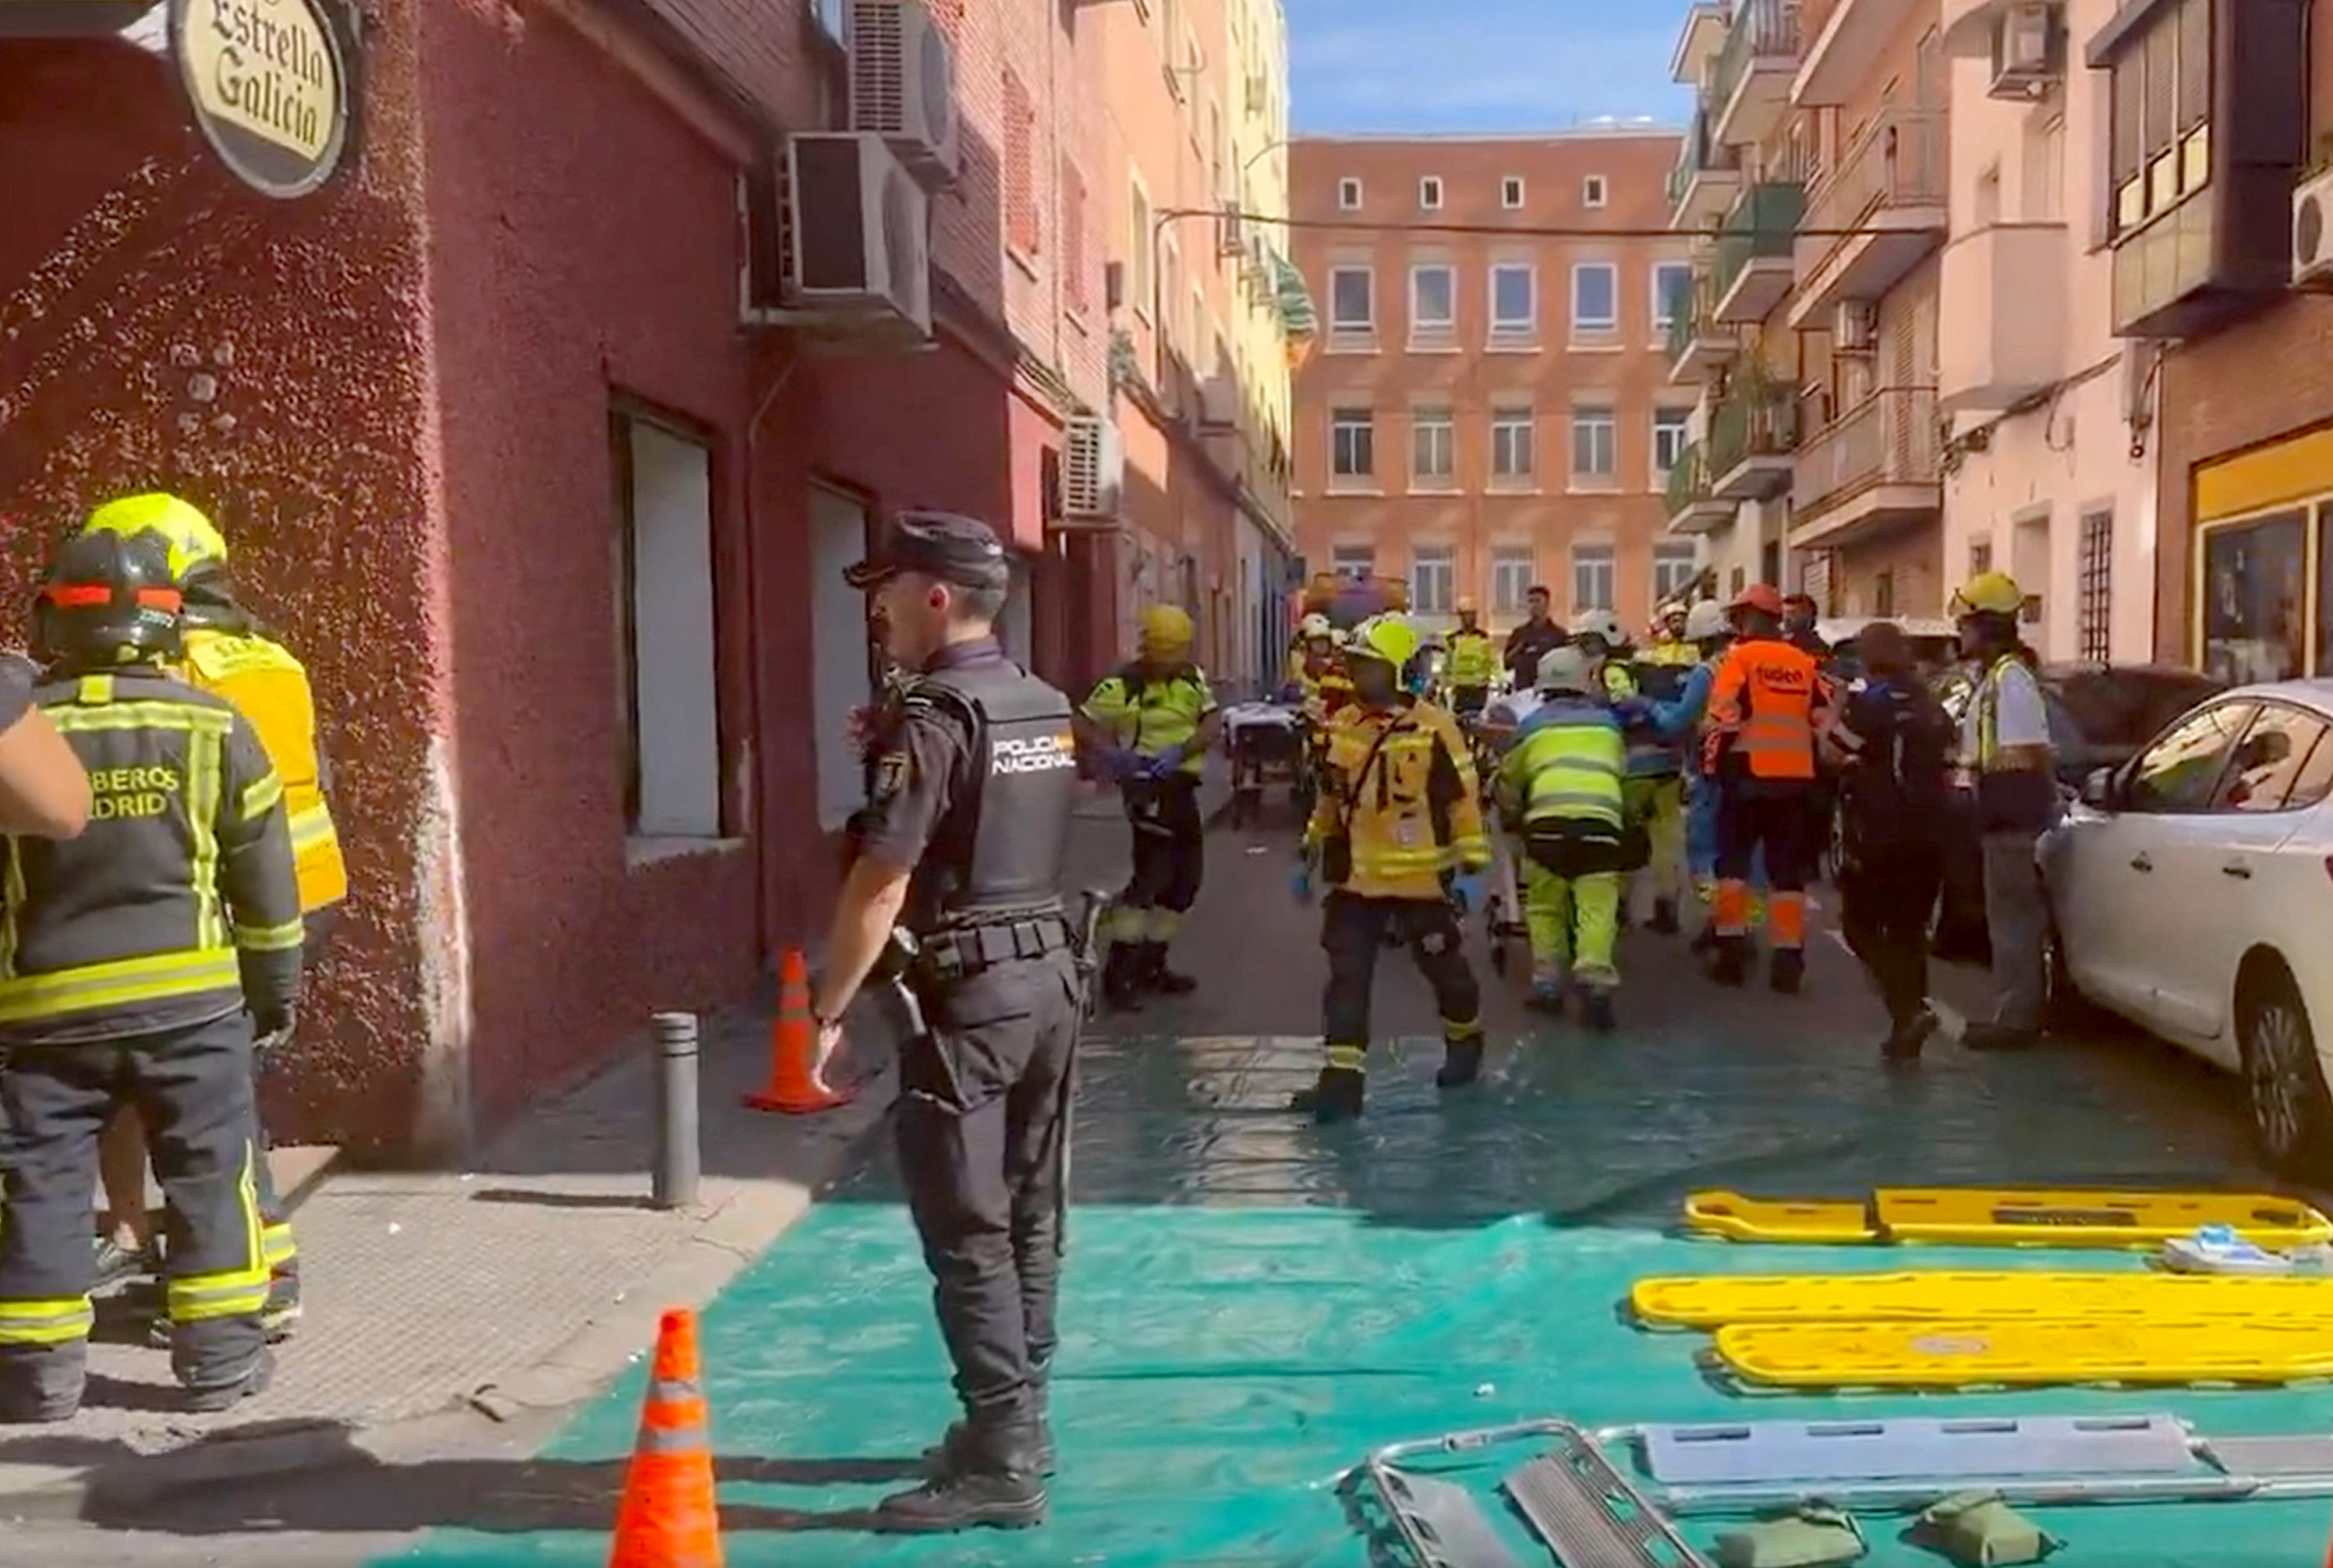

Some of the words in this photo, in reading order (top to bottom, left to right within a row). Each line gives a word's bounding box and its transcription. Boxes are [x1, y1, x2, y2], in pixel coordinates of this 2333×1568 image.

[211, 0, 324, 90] Estrella
[216, 46, 317, 147] Galicia
[88, 766, 180, 792] BEROS
[88, 792, 168, 820] DRID
